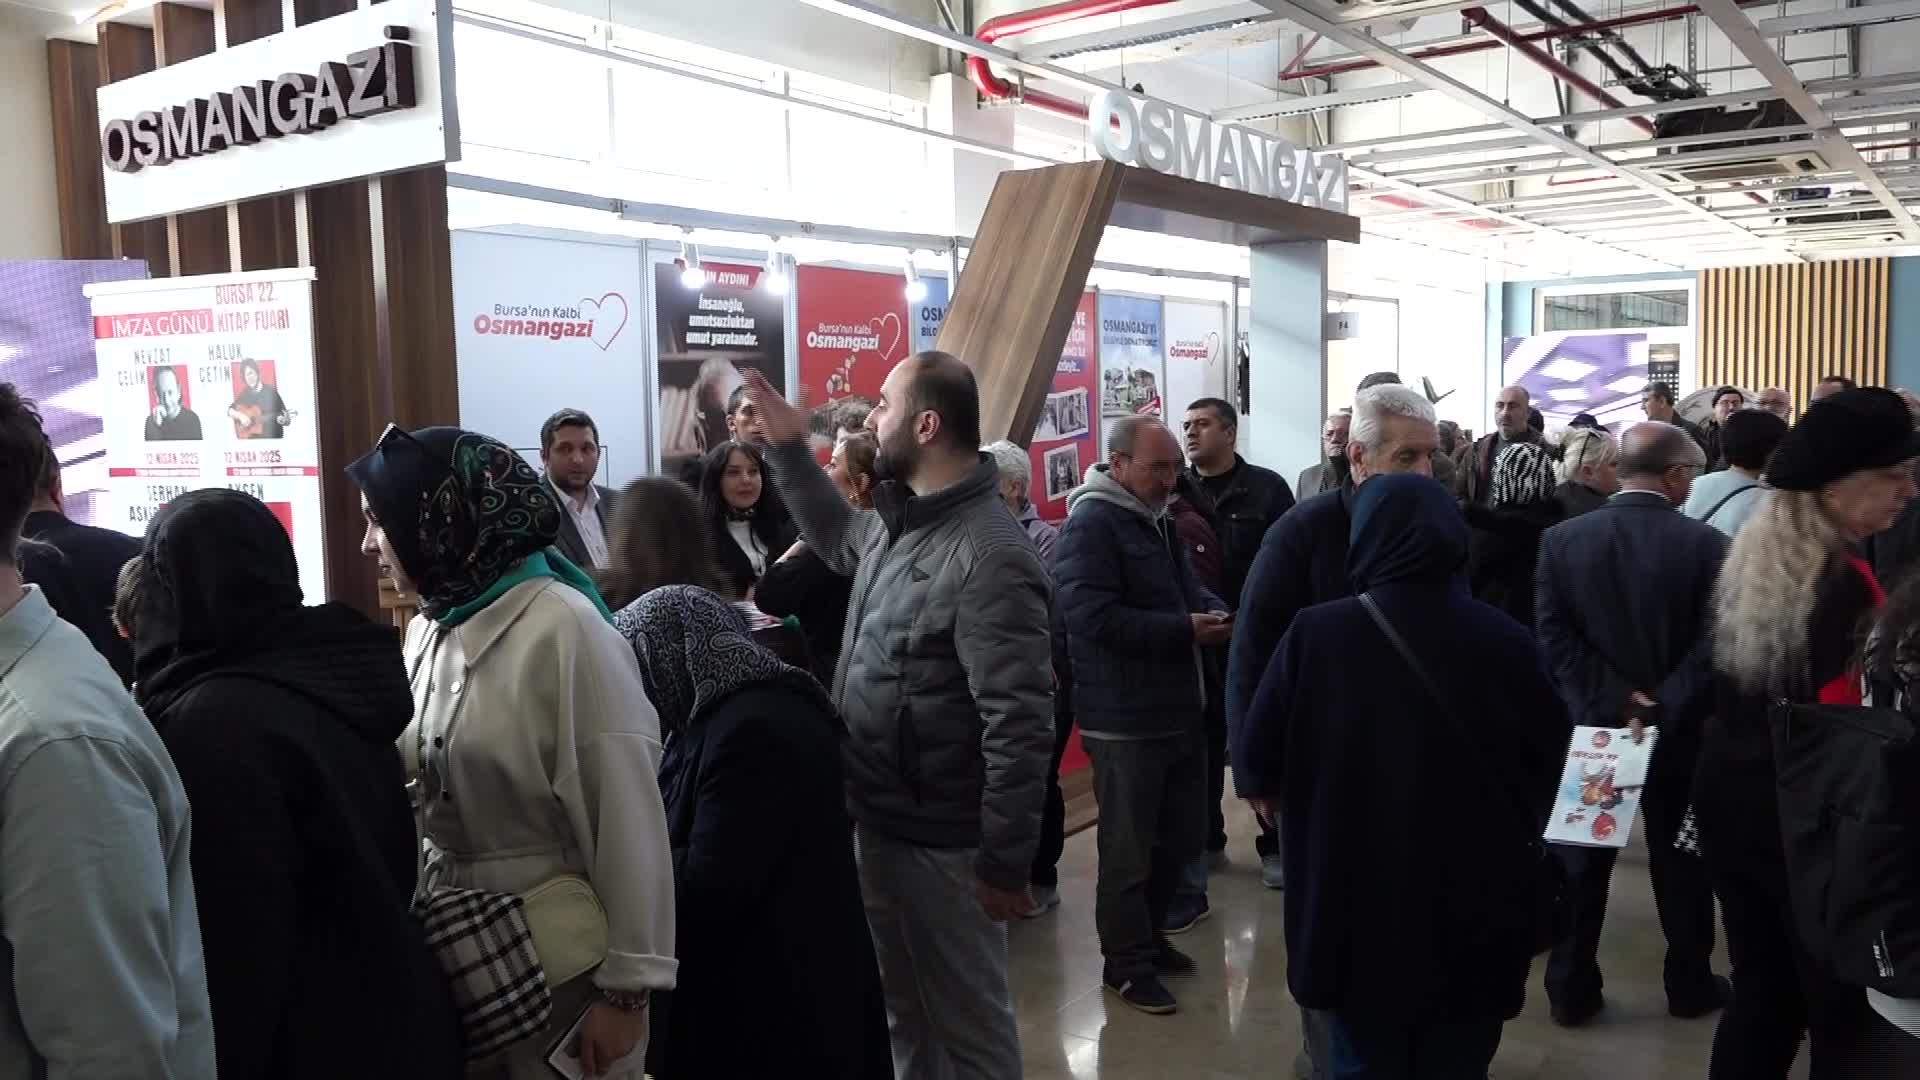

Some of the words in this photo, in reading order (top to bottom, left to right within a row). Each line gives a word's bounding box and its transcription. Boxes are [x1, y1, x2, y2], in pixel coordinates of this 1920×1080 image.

[216, 282, 255, 305] BURSA
[255, 307, 290, 331] FUARI
[553, 305, 581, 319] Kalbi
[111, 316, 155, 337] İMZA
[157, 311, 209, 334] GÜNÜ
[474, 314, 594, 341] Osmangazi
[686, 332, 711, 344] umut
[807, 331, 880, 353] Osmangazi
[259, 450, 281, 463] 2025
